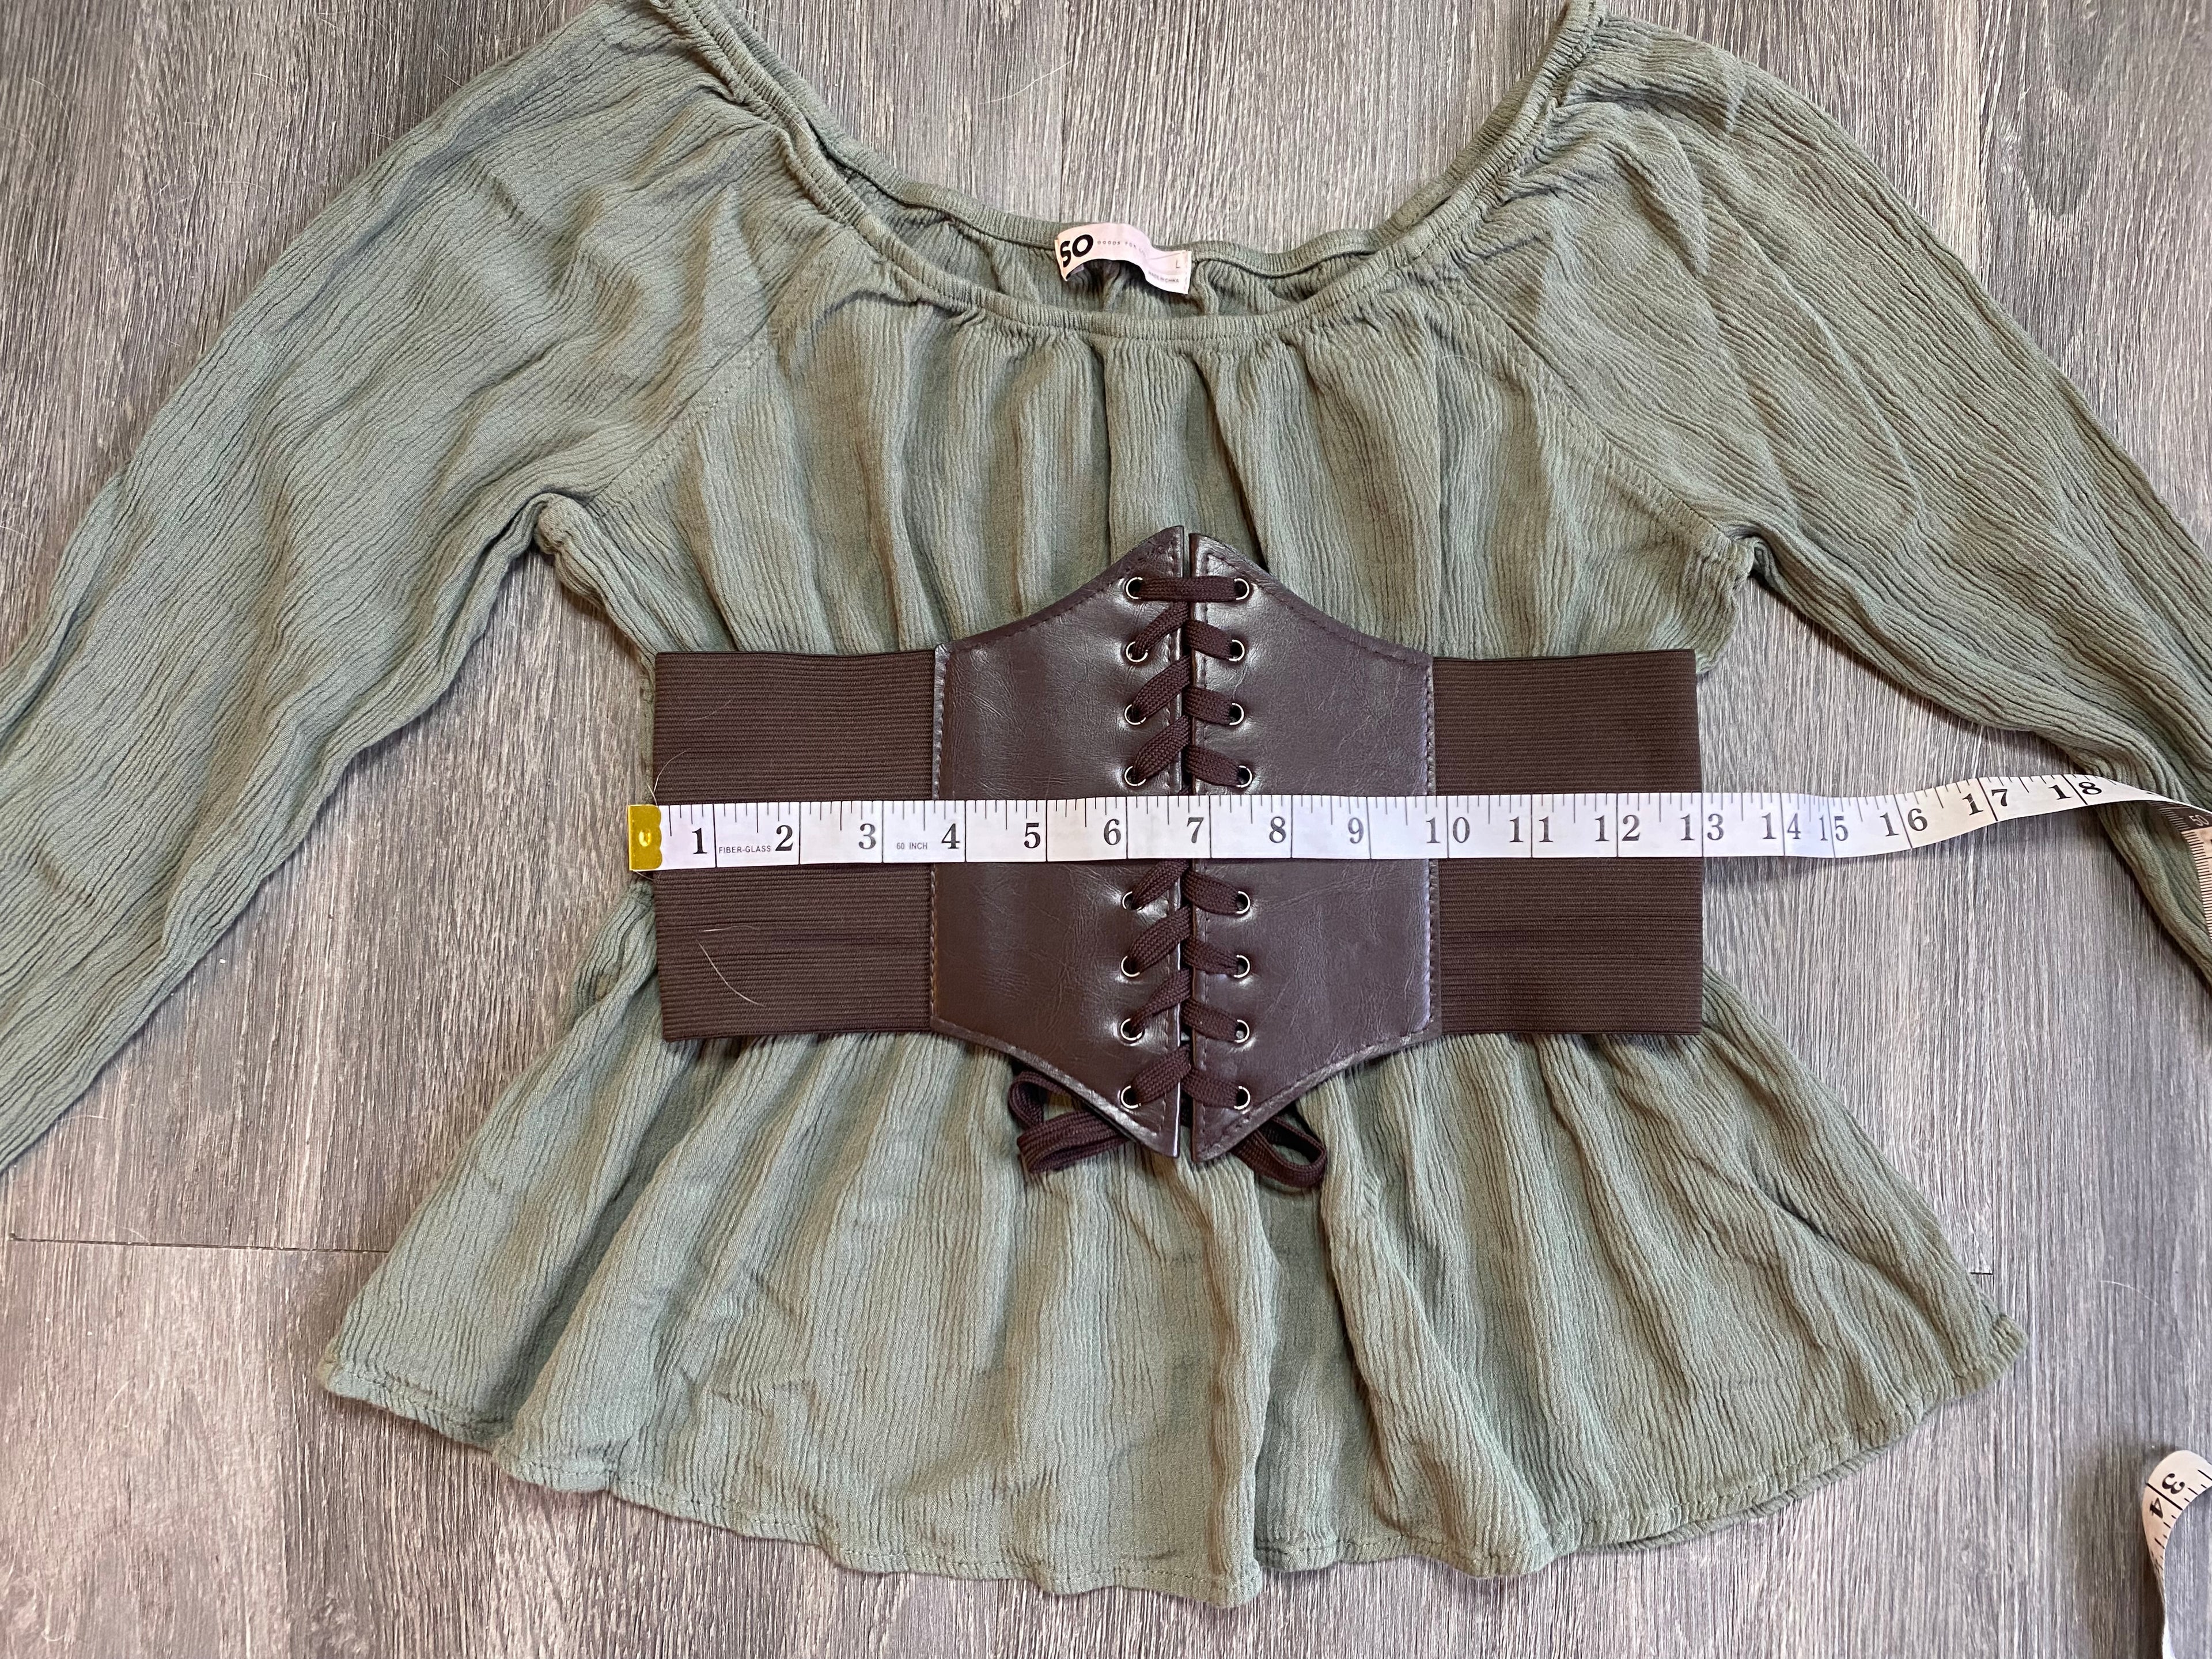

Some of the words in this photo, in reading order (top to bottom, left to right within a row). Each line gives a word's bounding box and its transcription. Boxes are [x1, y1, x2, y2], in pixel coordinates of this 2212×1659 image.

[1060, 234, 1094, 268] SO
[1176, 259, 1181, 269] L
[692, 828, 707, 854] 1
[775, 825, 793, 851] 2
[858, 824, 876, 850] 3
[941, 824, 960, 849] 4
[1024, 823, 1041, 849] 5
[1103, 819, 1121, 846] 6
[1187, 817, 1204, 843] 7
[1269, 816, 1286, 843] 8
[1348, 817, 1364, 844] 9
[1426, 817, 1470, 843] 10
[1509, 817, 1554, 842] 11
[1595, 815, 1641, 841] 12
[1680, 814, 1724, 840] 13
[1762, 813, 1801, 839] 14
[1819, 815, 1849, 842] 15
[1880, 809, 1928, 836] 16
[1961, 789, 2008, 815] 17
[2048, 782, 2103, 800] 18
[2189, 814, 2210, 827] 50
[719, 845, 771, 853] FIBER-GLASS
[896, 842, 905, 850] 60
